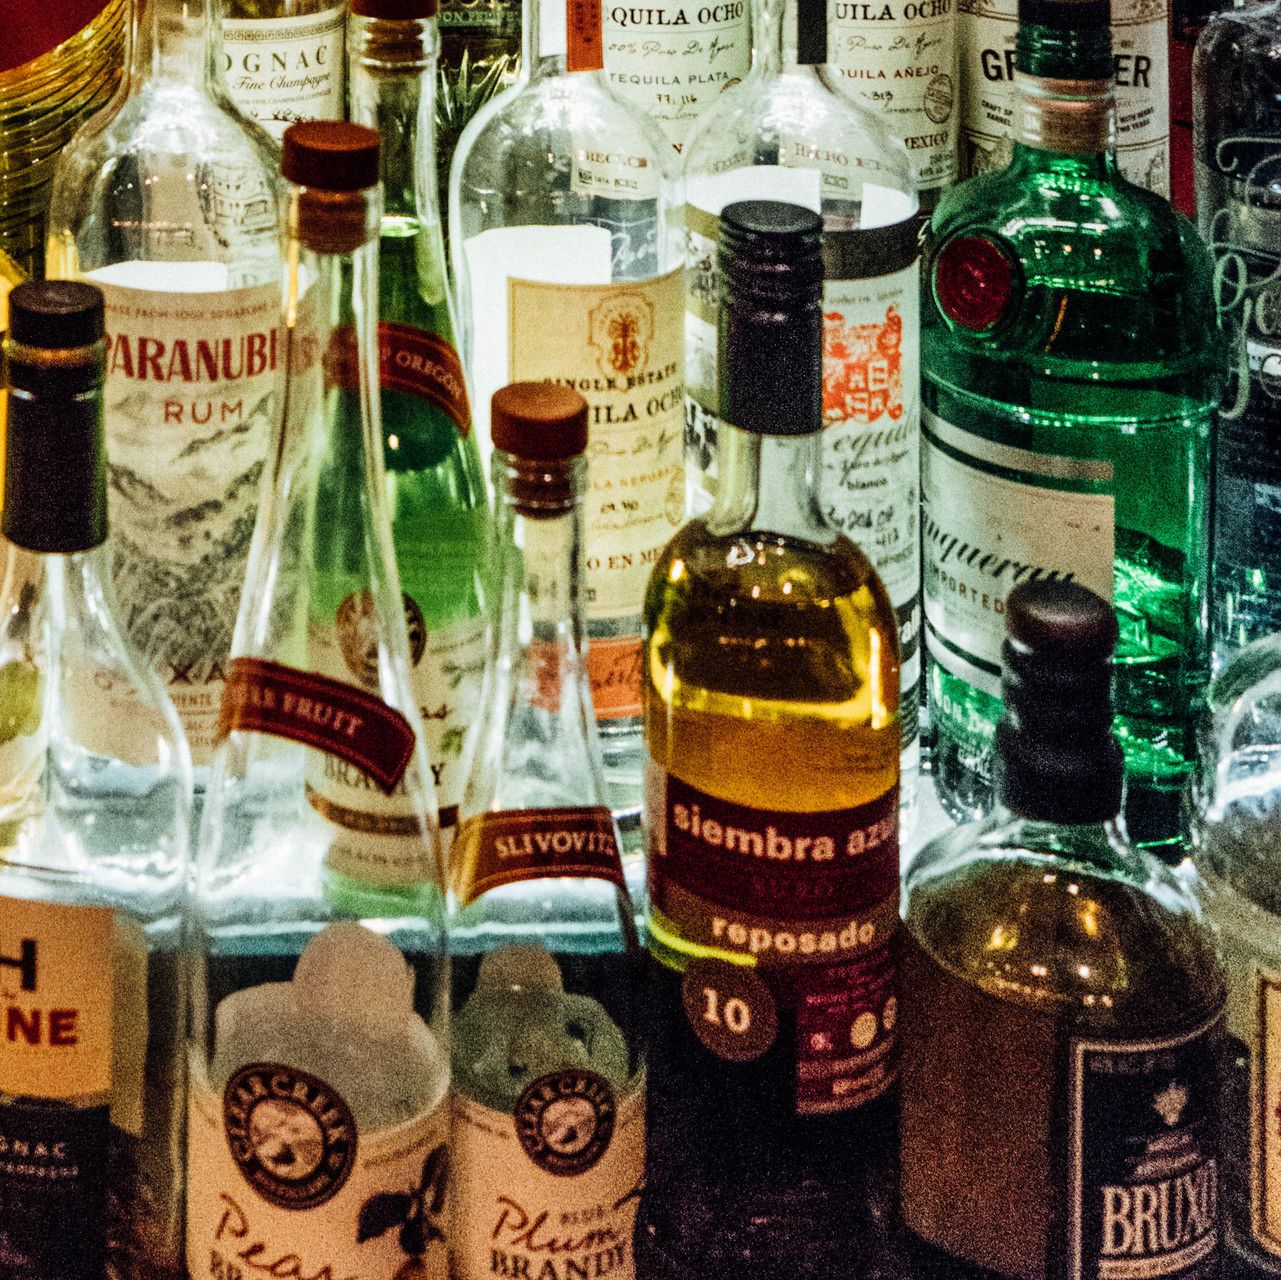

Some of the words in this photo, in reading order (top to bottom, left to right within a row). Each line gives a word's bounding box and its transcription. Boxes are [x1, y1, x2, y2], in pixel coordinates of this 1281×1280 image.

[610, 7, 687, 27] QUILA
[698, 2, 743, 25] OCHO
[238, 76, 264, 90] Fine
[270, 72, 330, 91] Champagne
[609, 72, 680, 85] TEQUILA
[688, 71, 731, 83] PLATA
[894, 65, 939, 79] AÑEJO
[104, 329, 277, 383] ARANUB
[626, 364, 678, 387] ESTATE
[163, 400, 243, 425] RUM
[673, 800, 835, 862] siembra
[844, 820, 900, 858] azu
[710, 916, 876, 955] reposado
[701, 986, 752, 1035] 10
[491, 1195, 628, 1256] Plum
